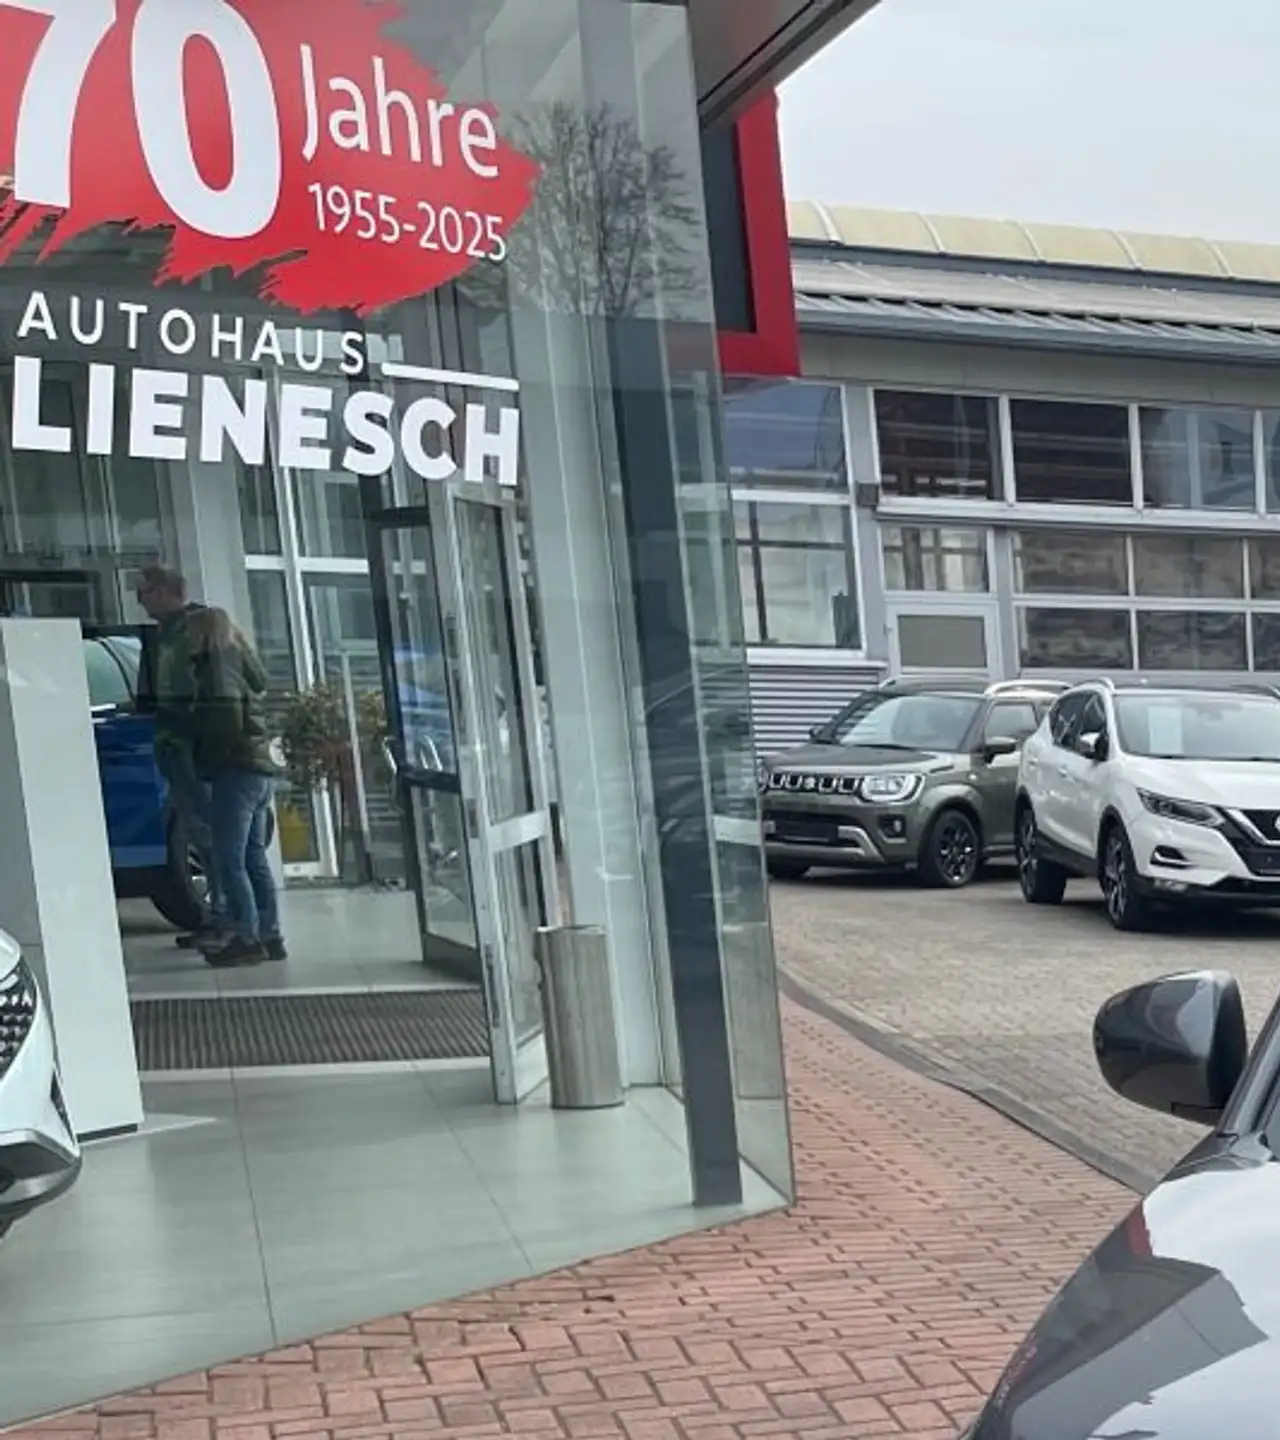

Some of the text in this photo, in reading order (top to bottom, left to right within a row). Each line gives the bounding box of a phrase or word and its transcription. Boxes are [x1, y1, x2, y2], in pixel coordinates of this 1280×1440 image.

[0, 0, 499, 238] 70 Jahre
[308, 182, 507, 261] 1955-2025
[16, 291, 365, 374] AUTOHAUS
[12, 355, 519, 485] LIENESCH
